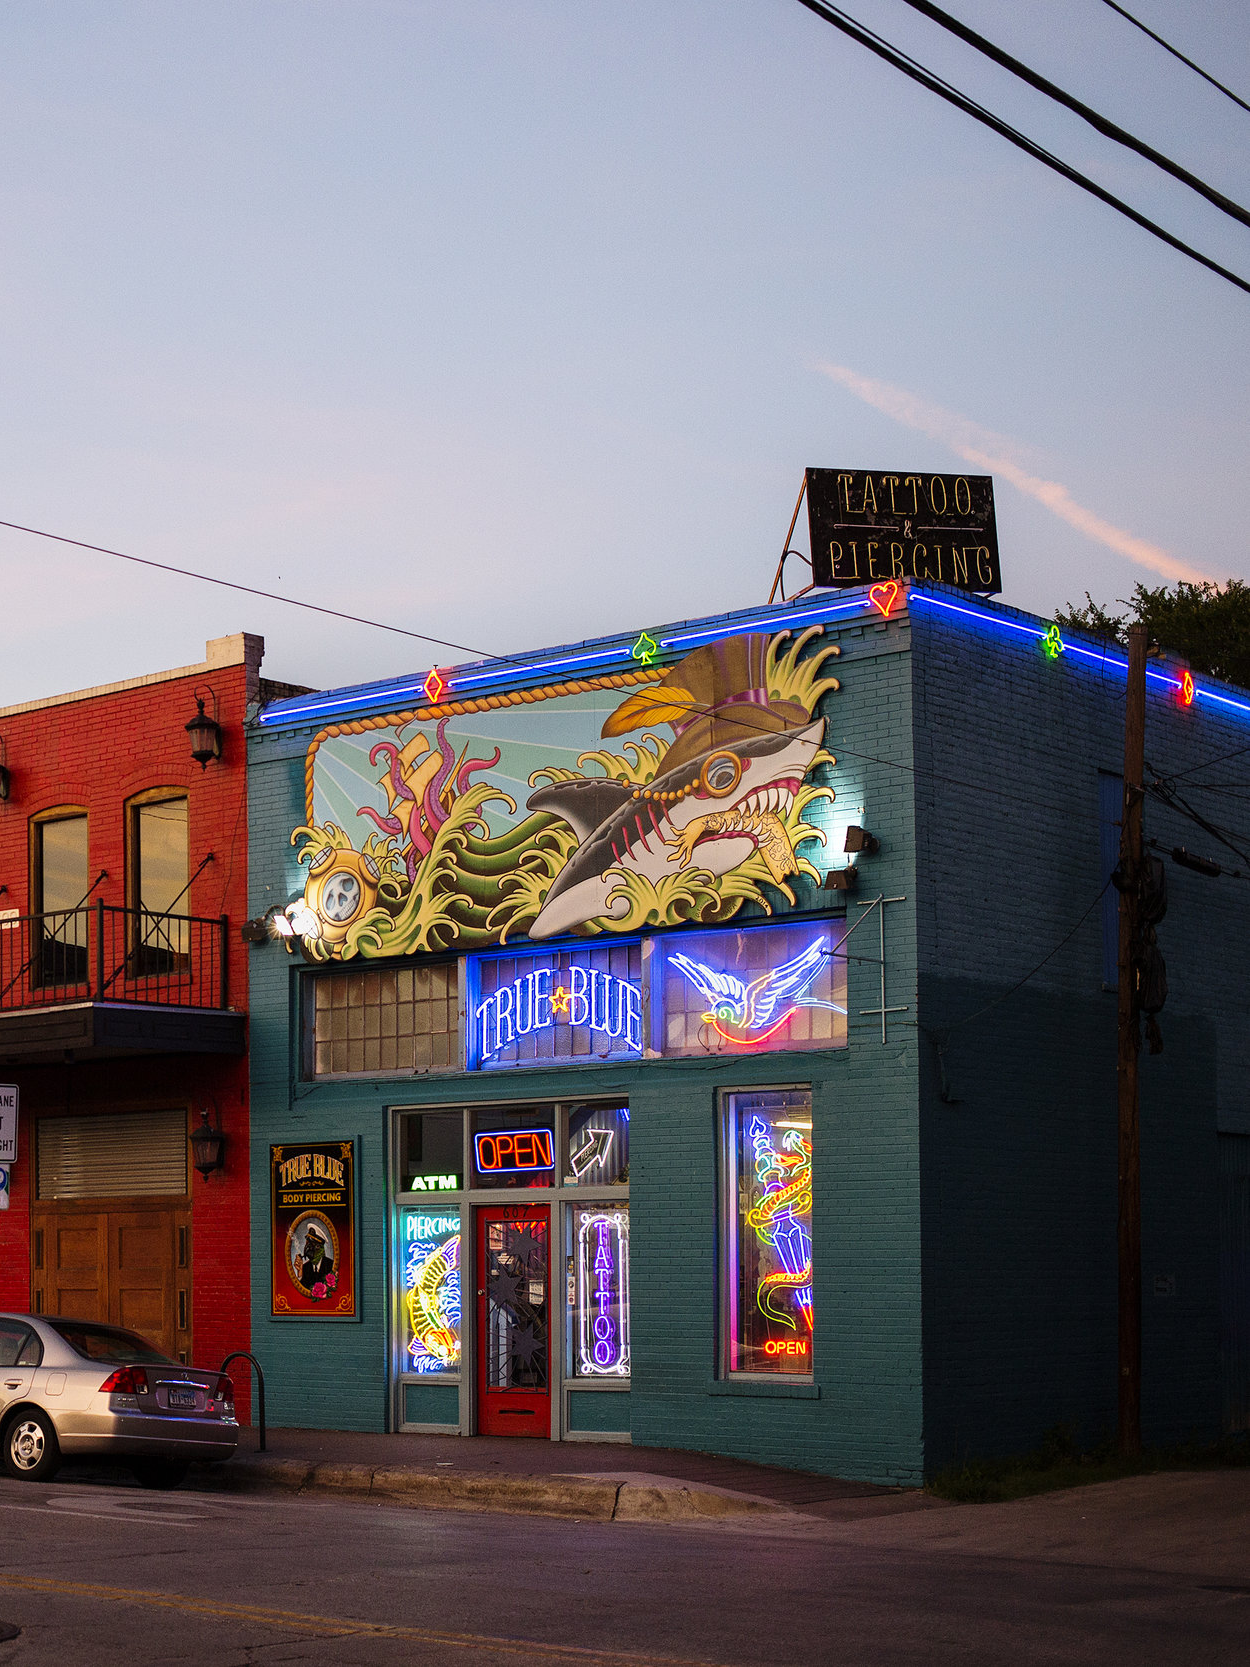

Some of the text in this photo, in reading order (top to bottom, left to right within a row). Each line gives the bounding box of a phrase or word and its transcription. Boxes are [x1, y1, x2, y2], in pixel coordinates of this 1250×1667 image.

[837, 474, 971, 516] TATTOO
[903, 519, 914, 539] &
[830, 540, 993, 585] PIERCING
[475, 965, 643, 1061] TRUE BLUE
[478, 1132, 552, 1169] OPEN
[279, 1153, 344, 1187] TRUE BLUE
[410, 1175, 457, 1191] ATM
[282, 1192, 341, 1204] BODY PIERCING
[503, 1207, 529, 1219] 607
[406, 1215, 461, 1241] PIERCING
[593, 1221, 611, 1365] TATTOO
[764, 1340, 807, 1355] OPEN
